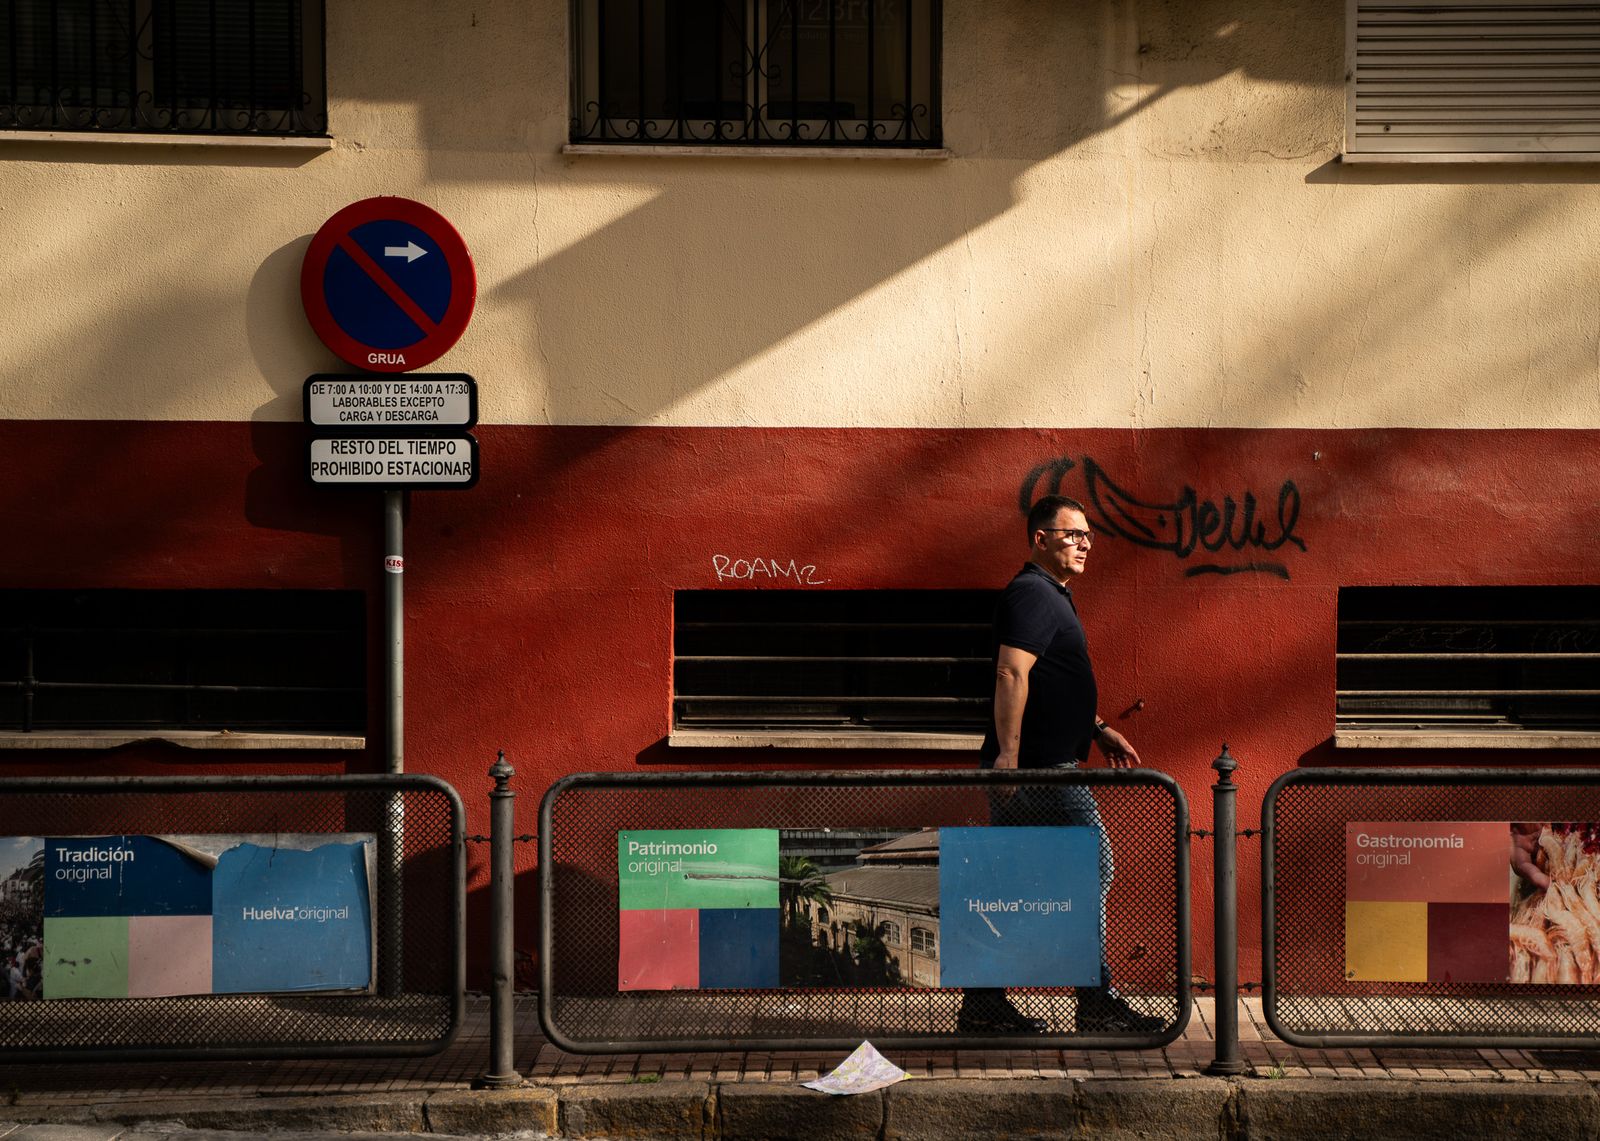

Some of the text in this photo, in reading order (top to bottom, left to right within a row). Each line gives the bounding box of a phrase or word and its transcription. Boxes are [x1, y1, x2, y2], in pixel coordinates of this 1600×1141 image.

[367, 352, 406, 365] GRUA
[312, 384, 469, 395] DE 7:00 A 10:00 Y DE 14:00 A 17:30
[332, 397, 445, 408] LABORABLES EXCEPTO
[339, 410, 439, 422] CARGA Y DESCARGA
[330, 440, 457, 455] RESTO DEL TIEMPO
[311, 461, 472, 476] PROHIBIDO ESTACIONAR
[628, 840, 718, 856] Patrimonio
[1356, 833, 1464, 849] Gastronomía
[55, 846, 135, 862] Tradición
[1356, 850, 1411, 869] original
[55, 864, 112, 883] original
[628, 857, 682, 876] original
